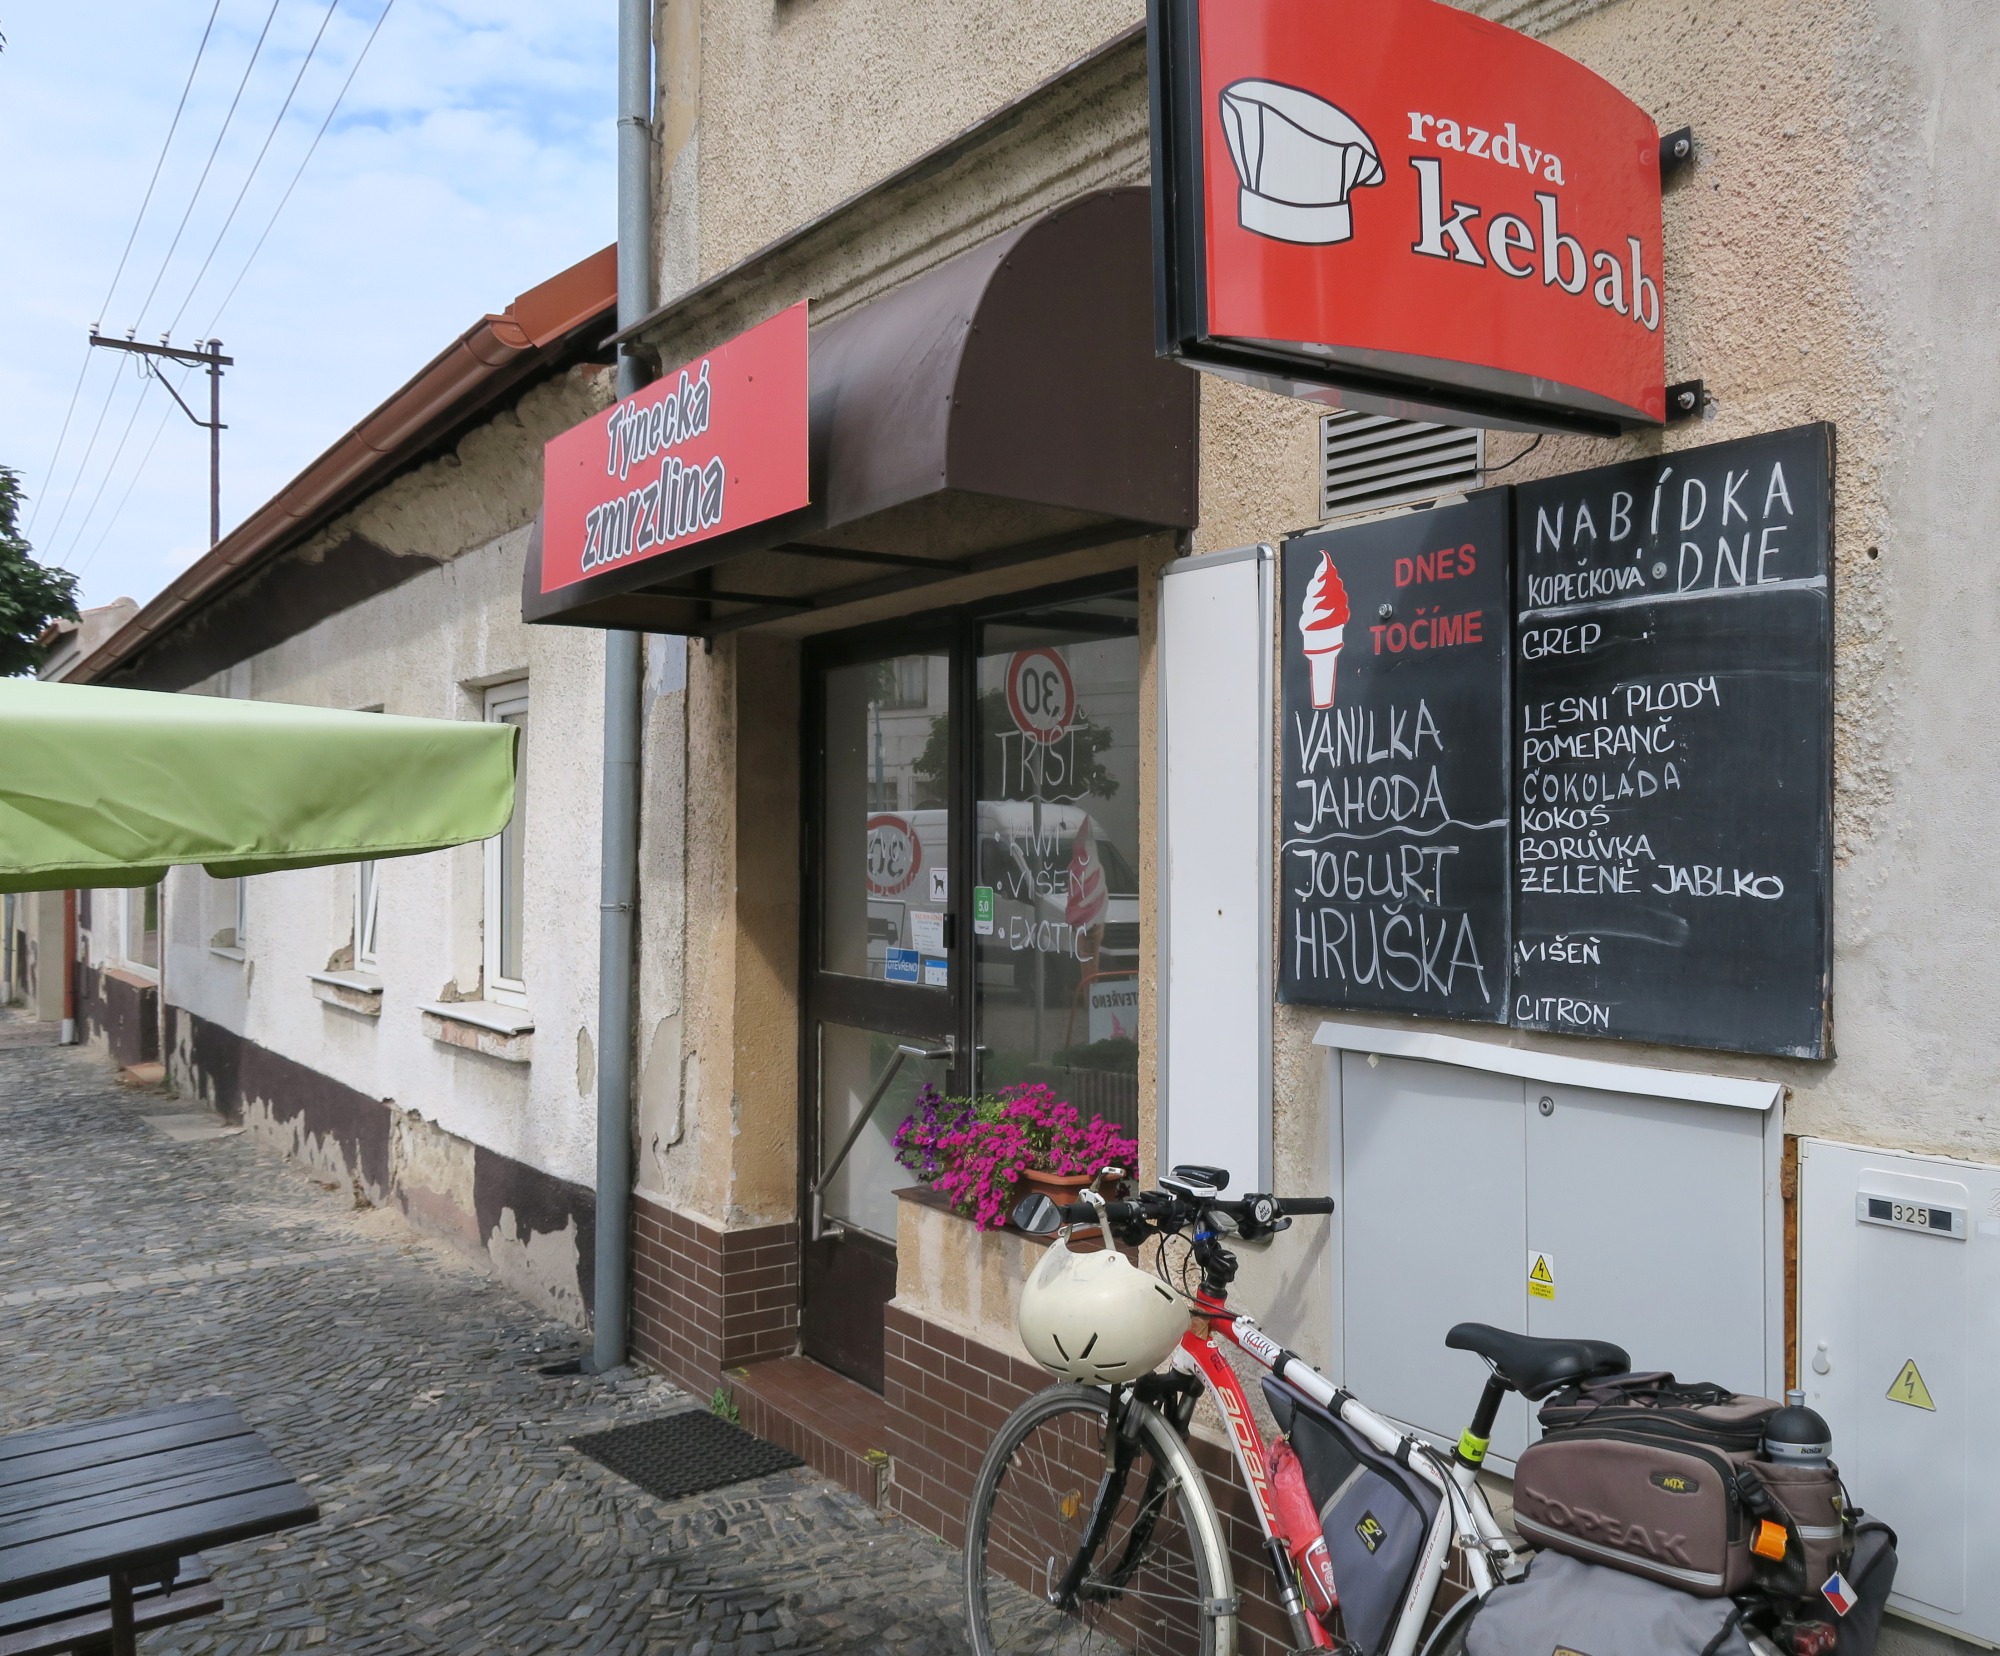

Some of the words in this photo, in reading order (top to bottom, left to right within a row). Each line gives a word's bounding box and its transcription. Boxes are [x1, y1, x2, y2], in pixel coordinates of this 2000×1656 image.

[1407, 111, 1565, 185] razdva
[1409, 156, 1660, 332] kebab
[607, 359, 711, 480] Týnecká
[581, 456, 725, 572] zmrzlina
[1535, 461, 1794, 553] NABÍDKA
[1395, 543, 1477, 588] DNES
[1527, 548, 1646, 607] KOPEČKOVÁ
[1677, 525, 1788, 593] DNE
[1369, 605, 1483, 656] TOČÍME
[1522, 623, 1601, 660] GREP
[1626, 676, 1721, 717] PLODY
[1295, 698, 1444, 774] VANILKA
[1522, 715, 1675, 769] POMERANČ
[1294, 765, 1450, 833] JAHODA
[1522, 757, 1681, 804] ČOKOLÁDA
[1519, 829, 1656, 864] BORŮVKA
[1293, 844, 1460, 907] JOGURT
[1652, 864, 1785, 900] JABLKO
[1010, 914, 1094, 963] EXOTIC
[1295, 903, 1491, 1004] HRUŠKA
[1518, 934, 1601, 965] VIŠEŇ
[887, 957, 918, 974] OTEVŘENO
[1516, 994, 1610, 1029] CITRON
[1893, 1204, 1928, 1225] 325
[1663, 1478, 1686, 1490] MTX
[1524, 1486, 1692, 1566] TOPEAK
